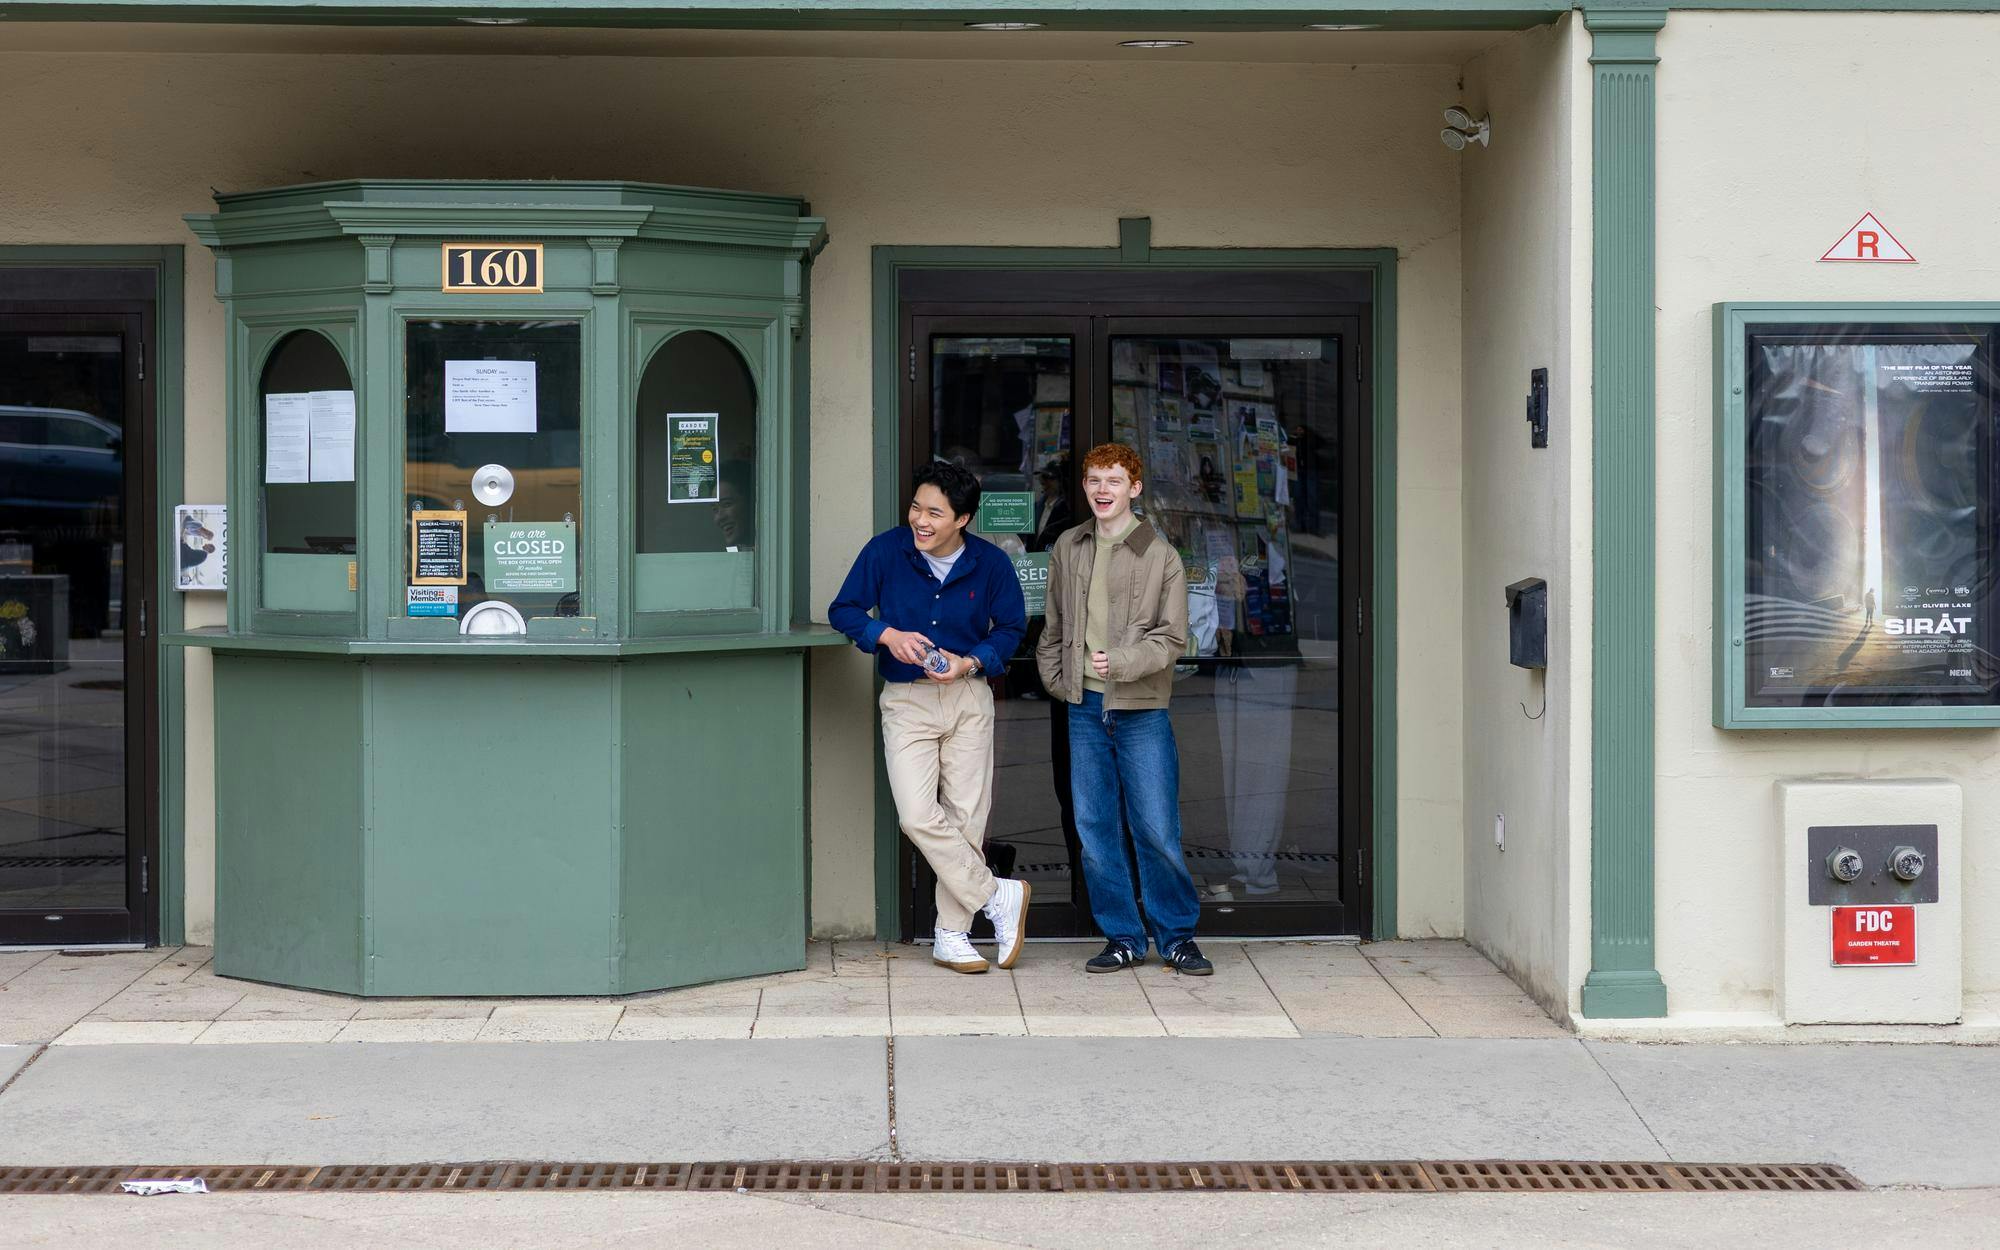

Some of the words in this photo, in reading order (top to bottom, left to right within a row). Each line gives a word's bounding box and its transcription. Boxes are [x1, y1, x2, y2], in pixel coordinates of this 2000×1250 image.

[1857, 231, 1879, 257] R
[458, 250, 527, 286] 160
[510, 530, 526, 538] we
[528, 530, 547, 538] are
[494, 540, 565, 555] CLOSED
[1016, 559, 1033, 567] are
[410, 588, 438, 597] Visiting
[1855, 910, 1893, 932] FDC
